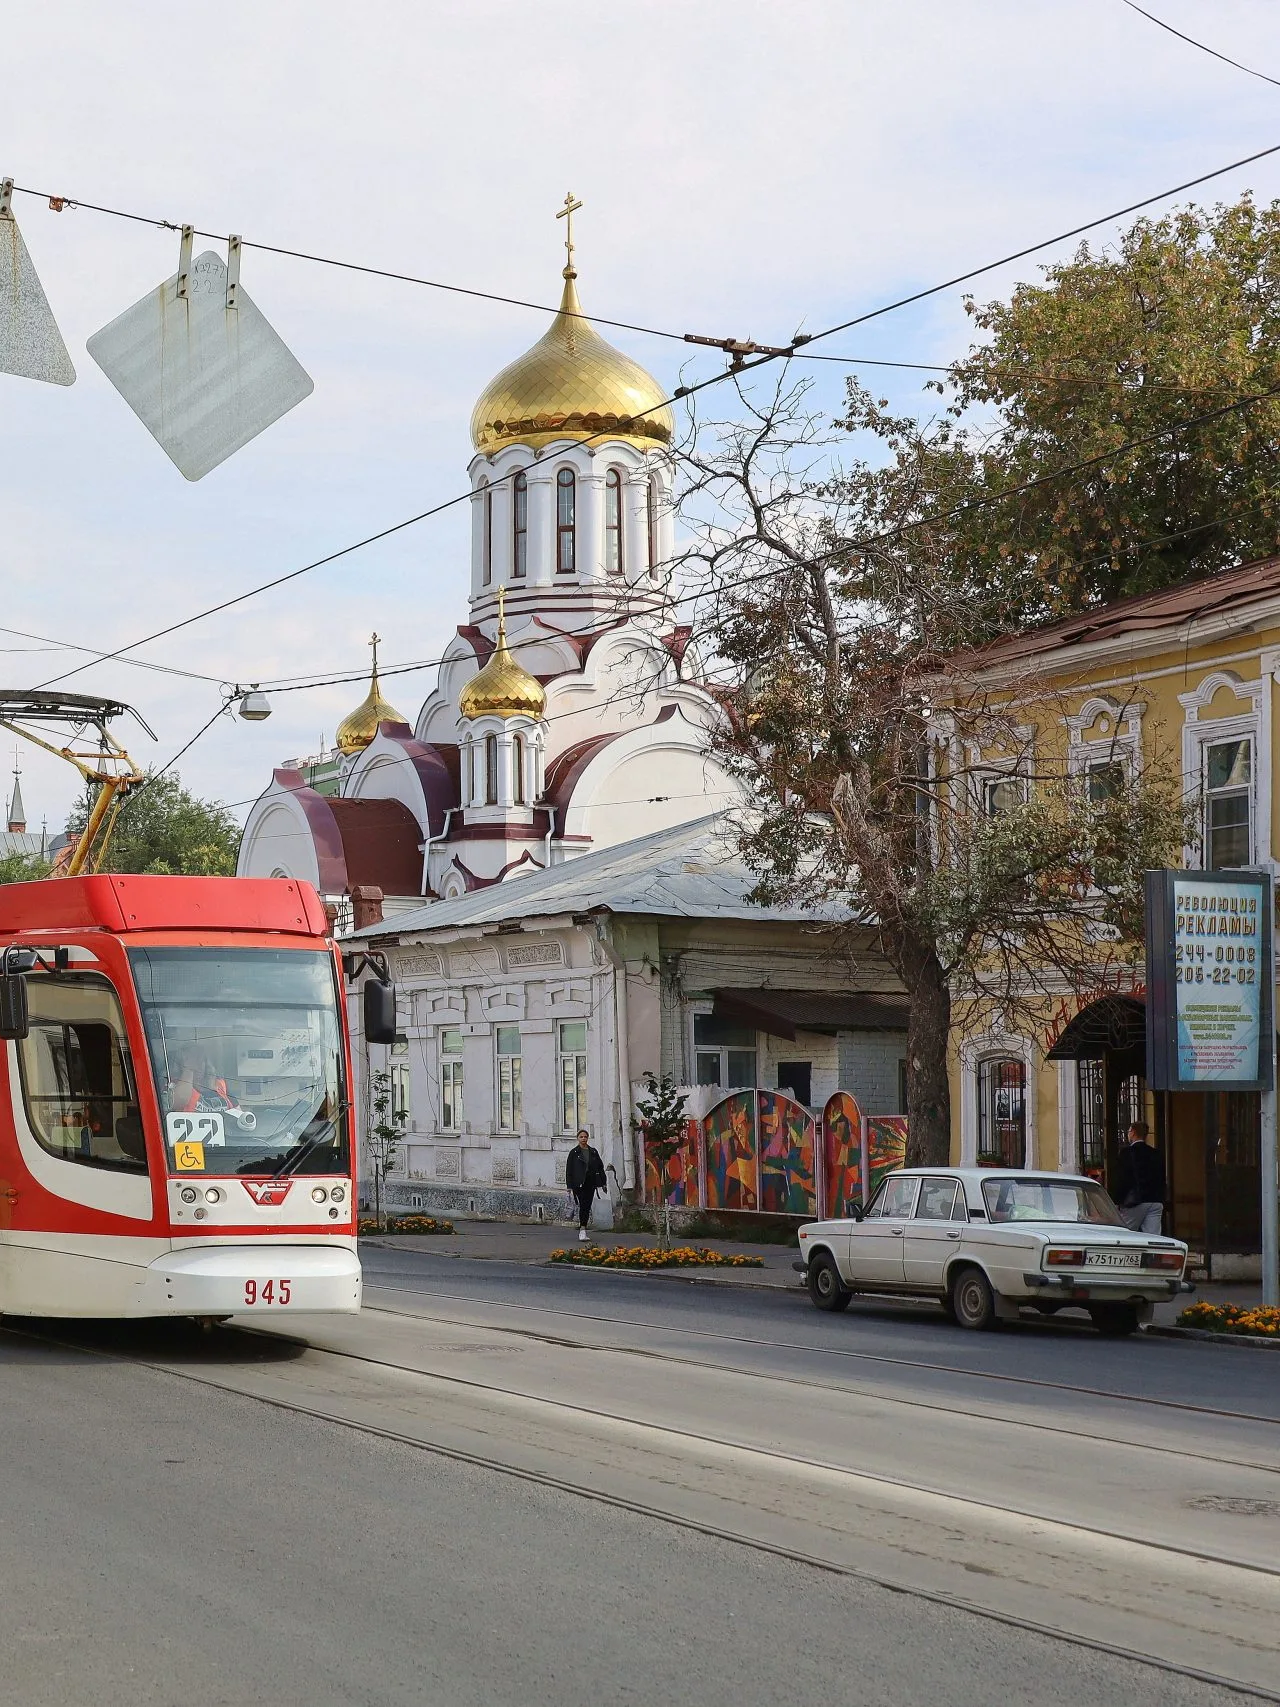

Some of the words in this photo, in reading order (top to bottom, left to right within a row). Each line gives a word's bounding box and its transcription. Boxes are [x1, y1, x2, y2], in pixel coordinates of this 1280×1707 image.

[1176, 895, 1256, 914] РЕВОЛЮЦИЯ
[1176, 914, 1256, 936] РЕКЛАМЫ
[1176, 944, 1255, 962] 244-0008
[1176, 966, 1255, 984] 205-22-02
[173, 1118, 219, 1147] 22
[244, 1279, 291, 1305] 945
